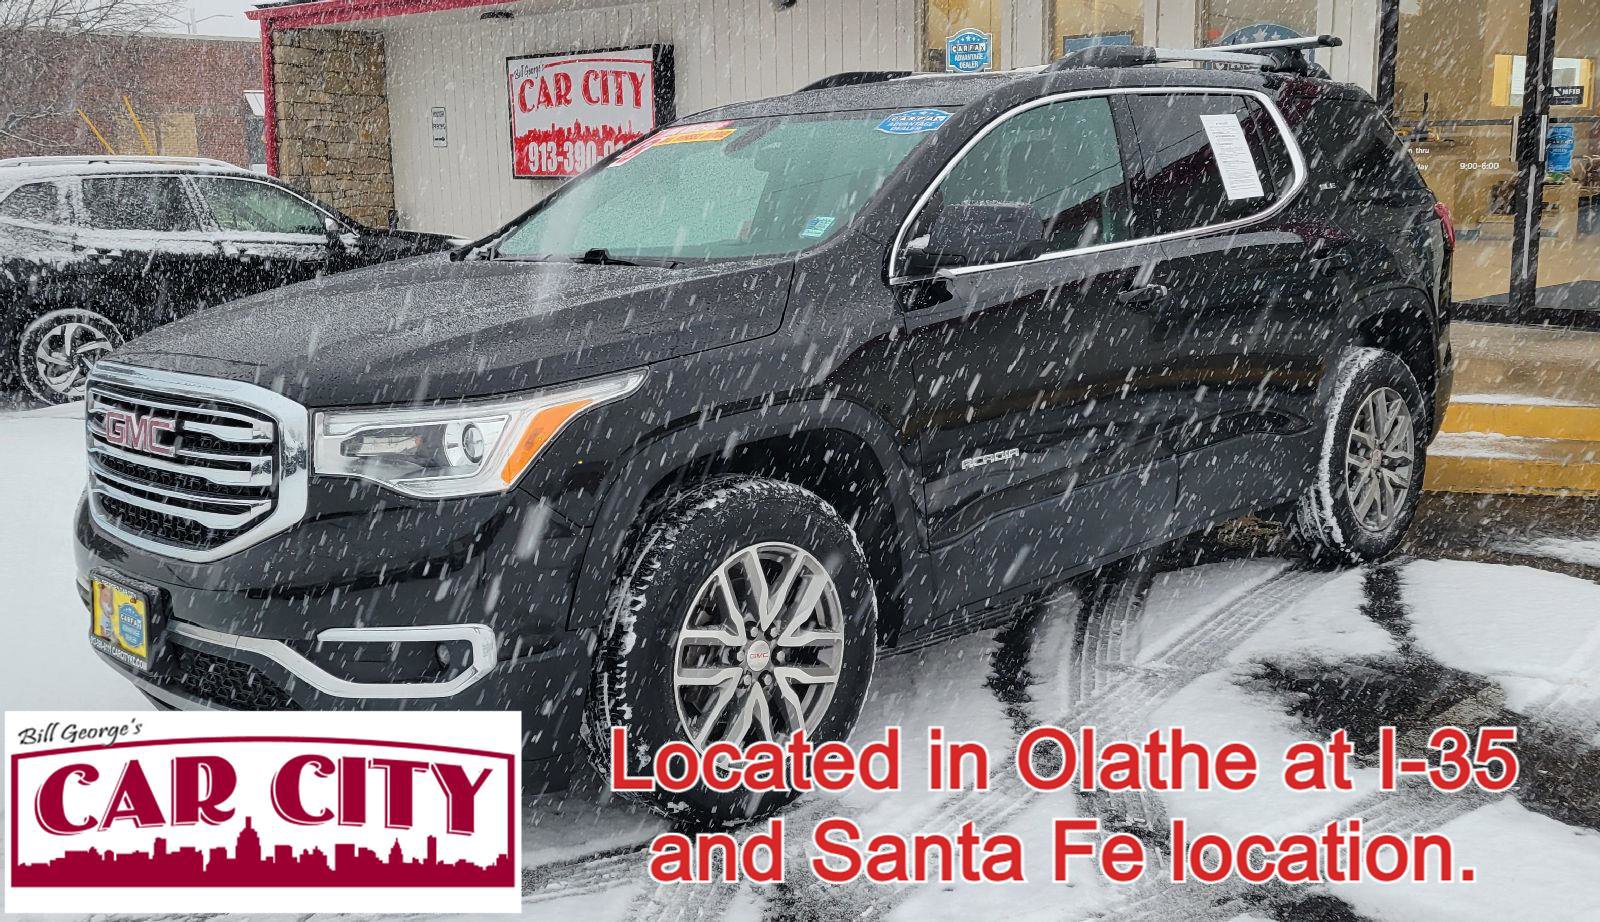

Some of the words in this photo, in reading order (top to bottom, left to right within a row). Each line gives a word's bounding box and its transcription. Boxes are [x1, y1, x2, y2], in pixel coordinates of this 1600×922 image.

[952, 43, 986, 52] CARFAX
[955, 53, 984, 62] ADVANTAGE
[959, 60, 979, 69] DEALER
[518, 72, 573, 114] CAR
[581, 70, 646, 110] CITY
[1459, 162, 1500, 170] 9:00-6:00
[106, 410, 176, 457] GMC
[961, 448, 1019, 470] ACADIA
